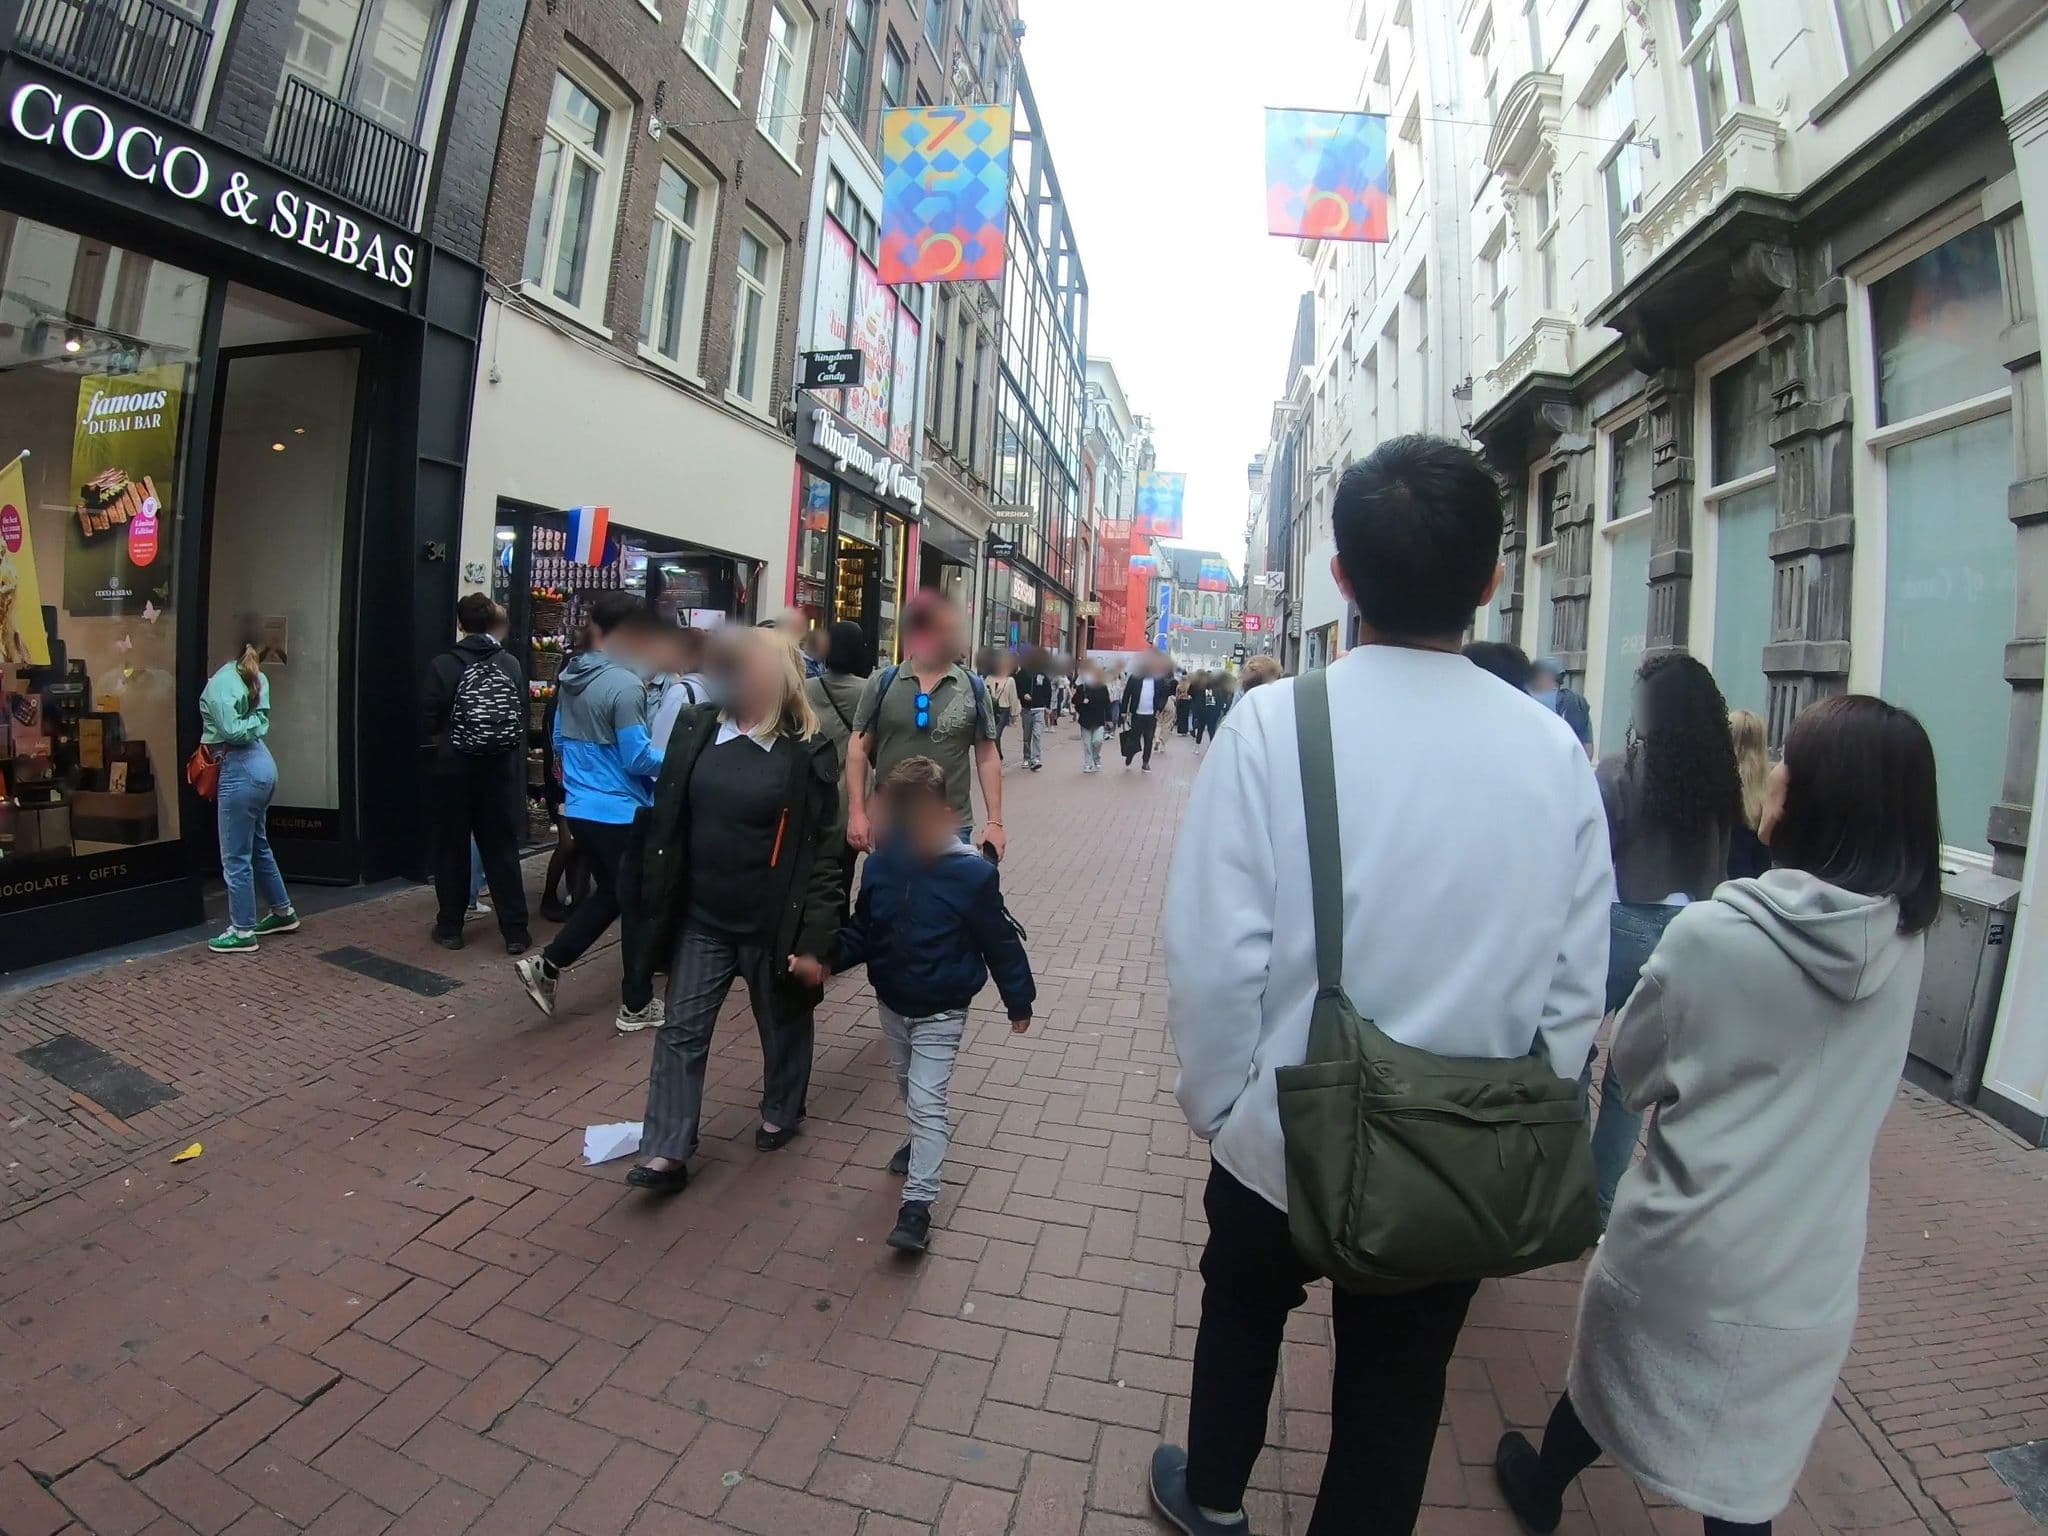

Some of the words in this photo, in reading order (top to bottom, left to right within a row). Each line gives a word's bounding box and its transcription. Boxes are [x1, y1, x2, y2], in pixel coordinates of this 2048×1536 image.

[10, 83, 210, 199] COCO
[219, 171, 260, 226] &
[269, 189, 415, 289] SEBAS
[814, 352, 853, 363] Kingdom
[827, 362, 838, 371] of
[817, 371, 846, 382] Candy
[82, 390, 168, 425] famous
[89, 415, 131, 436] DUBAI
[134, 413, 161, 431] BAR
[812, 408, 874, 478] Kingdom
[873, 456, 891, 496] of
[889, 463, 923, 516] Candy
[0, 874, 70, 899] OCOLATE
[88, 864, 128, 881] GIFTS
